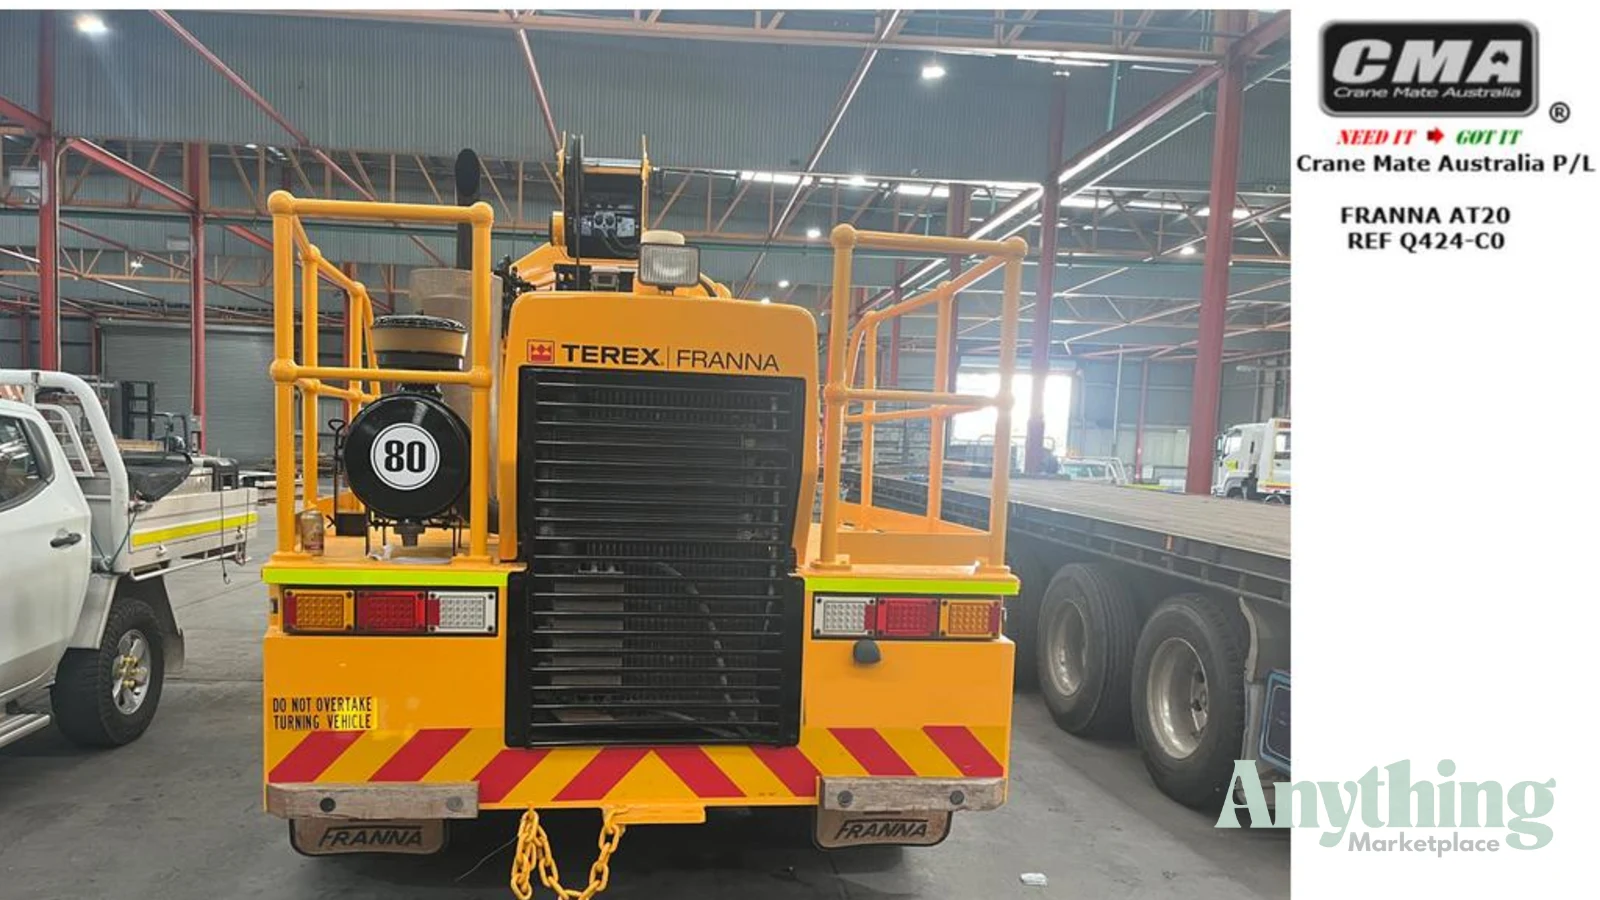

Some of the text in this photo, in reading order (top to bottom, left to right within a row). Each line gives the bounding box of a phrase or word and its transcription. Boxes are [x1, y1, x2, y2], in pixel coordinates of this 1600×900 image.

[561, 345, 780, 371] TEREX FRANNA
[384, 440, 426, 473] 80
[272, 696, 373, 713] DO NOT OVERTAKE
[272, 714, 372, 731] TURNING VEHICLE
[318, 826, 424, 849] FRANNA
[834, 819, 929, 841] FRANNA
